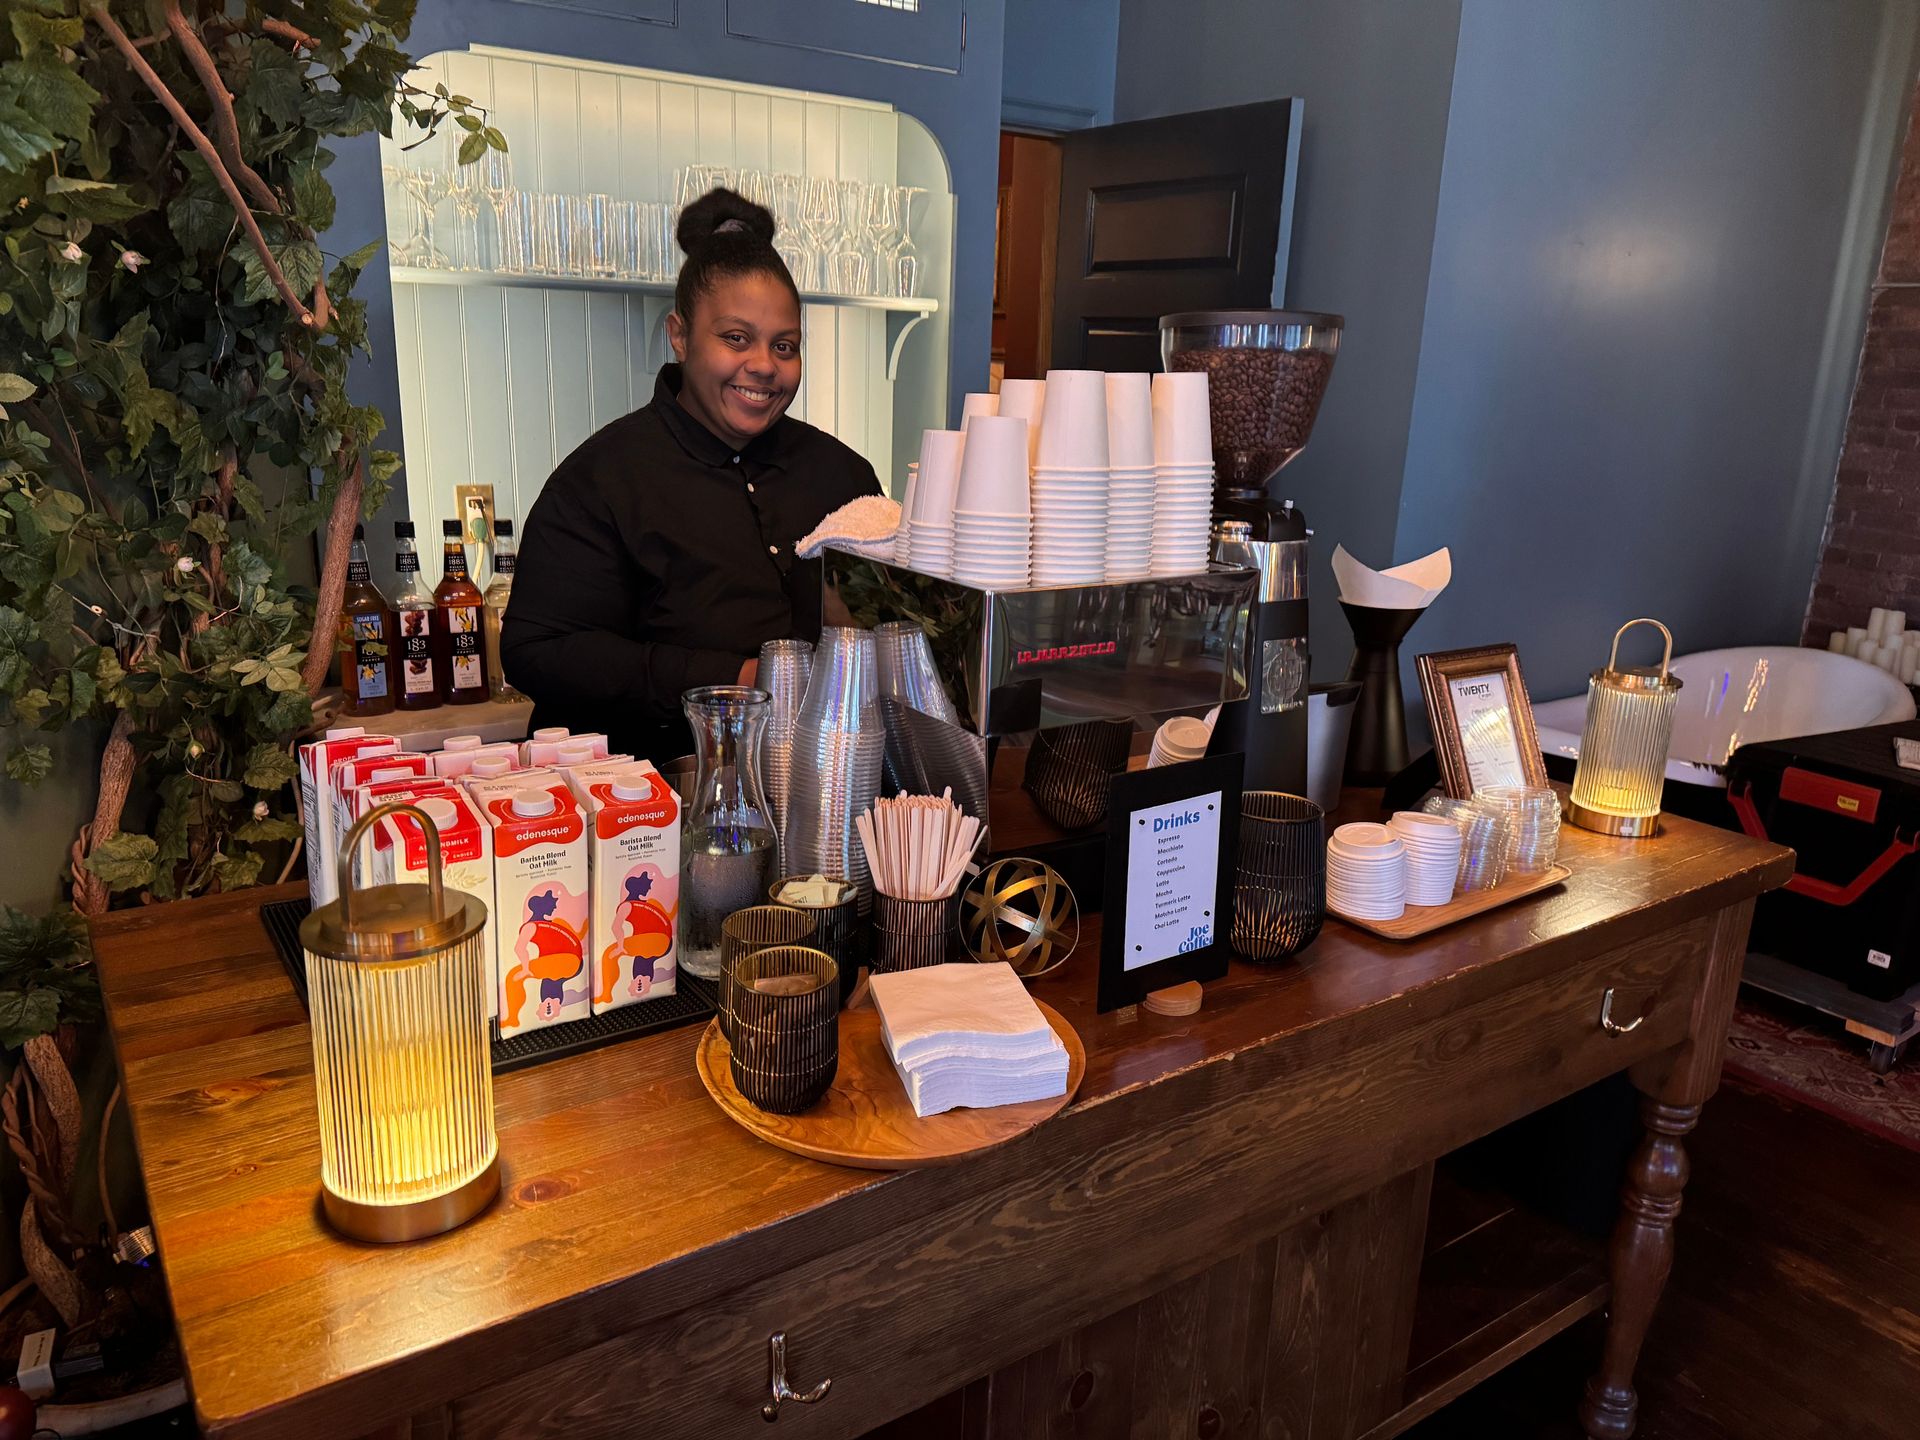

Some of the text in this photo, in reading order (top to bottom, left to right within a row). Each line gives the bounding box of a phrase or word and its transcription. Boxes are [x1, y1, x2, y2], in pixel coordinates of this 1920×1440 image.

[407, 637, 426, 652] 1883
[456, 634, 475, 648] 1883
[1458, 684, 1489, 697] TWENTY
[617, 811, 665, 824] edenesque
[1154, 811, 1200, 832] Drinks
[516, 826, 570, 841] edenesque
[620, 833, 662, 846] Barista Blend
[1158, 835, 1180, 844] Espresso
[640, 842, 654, 850] Milk
[1158, 845, 1184, 854] Macchiato
[520, 850, 567, 865] Barista Blend
[1157, 857, 1178, 865] Cortado
[529, 858, 558, 870] Oat Milk
[1157, 865, 1185, 876] Cappuccino
[1156, 880, 1169, 888] Latte
[1156, 890, 1173, 898] Mocha
[1155, 898, 1177, 908] Turmeric
[1155, 910, 1174, 919] Matcha
[1154, 921, 1165, 930] Chai
[1188, 924, 1209, 942] Joe
